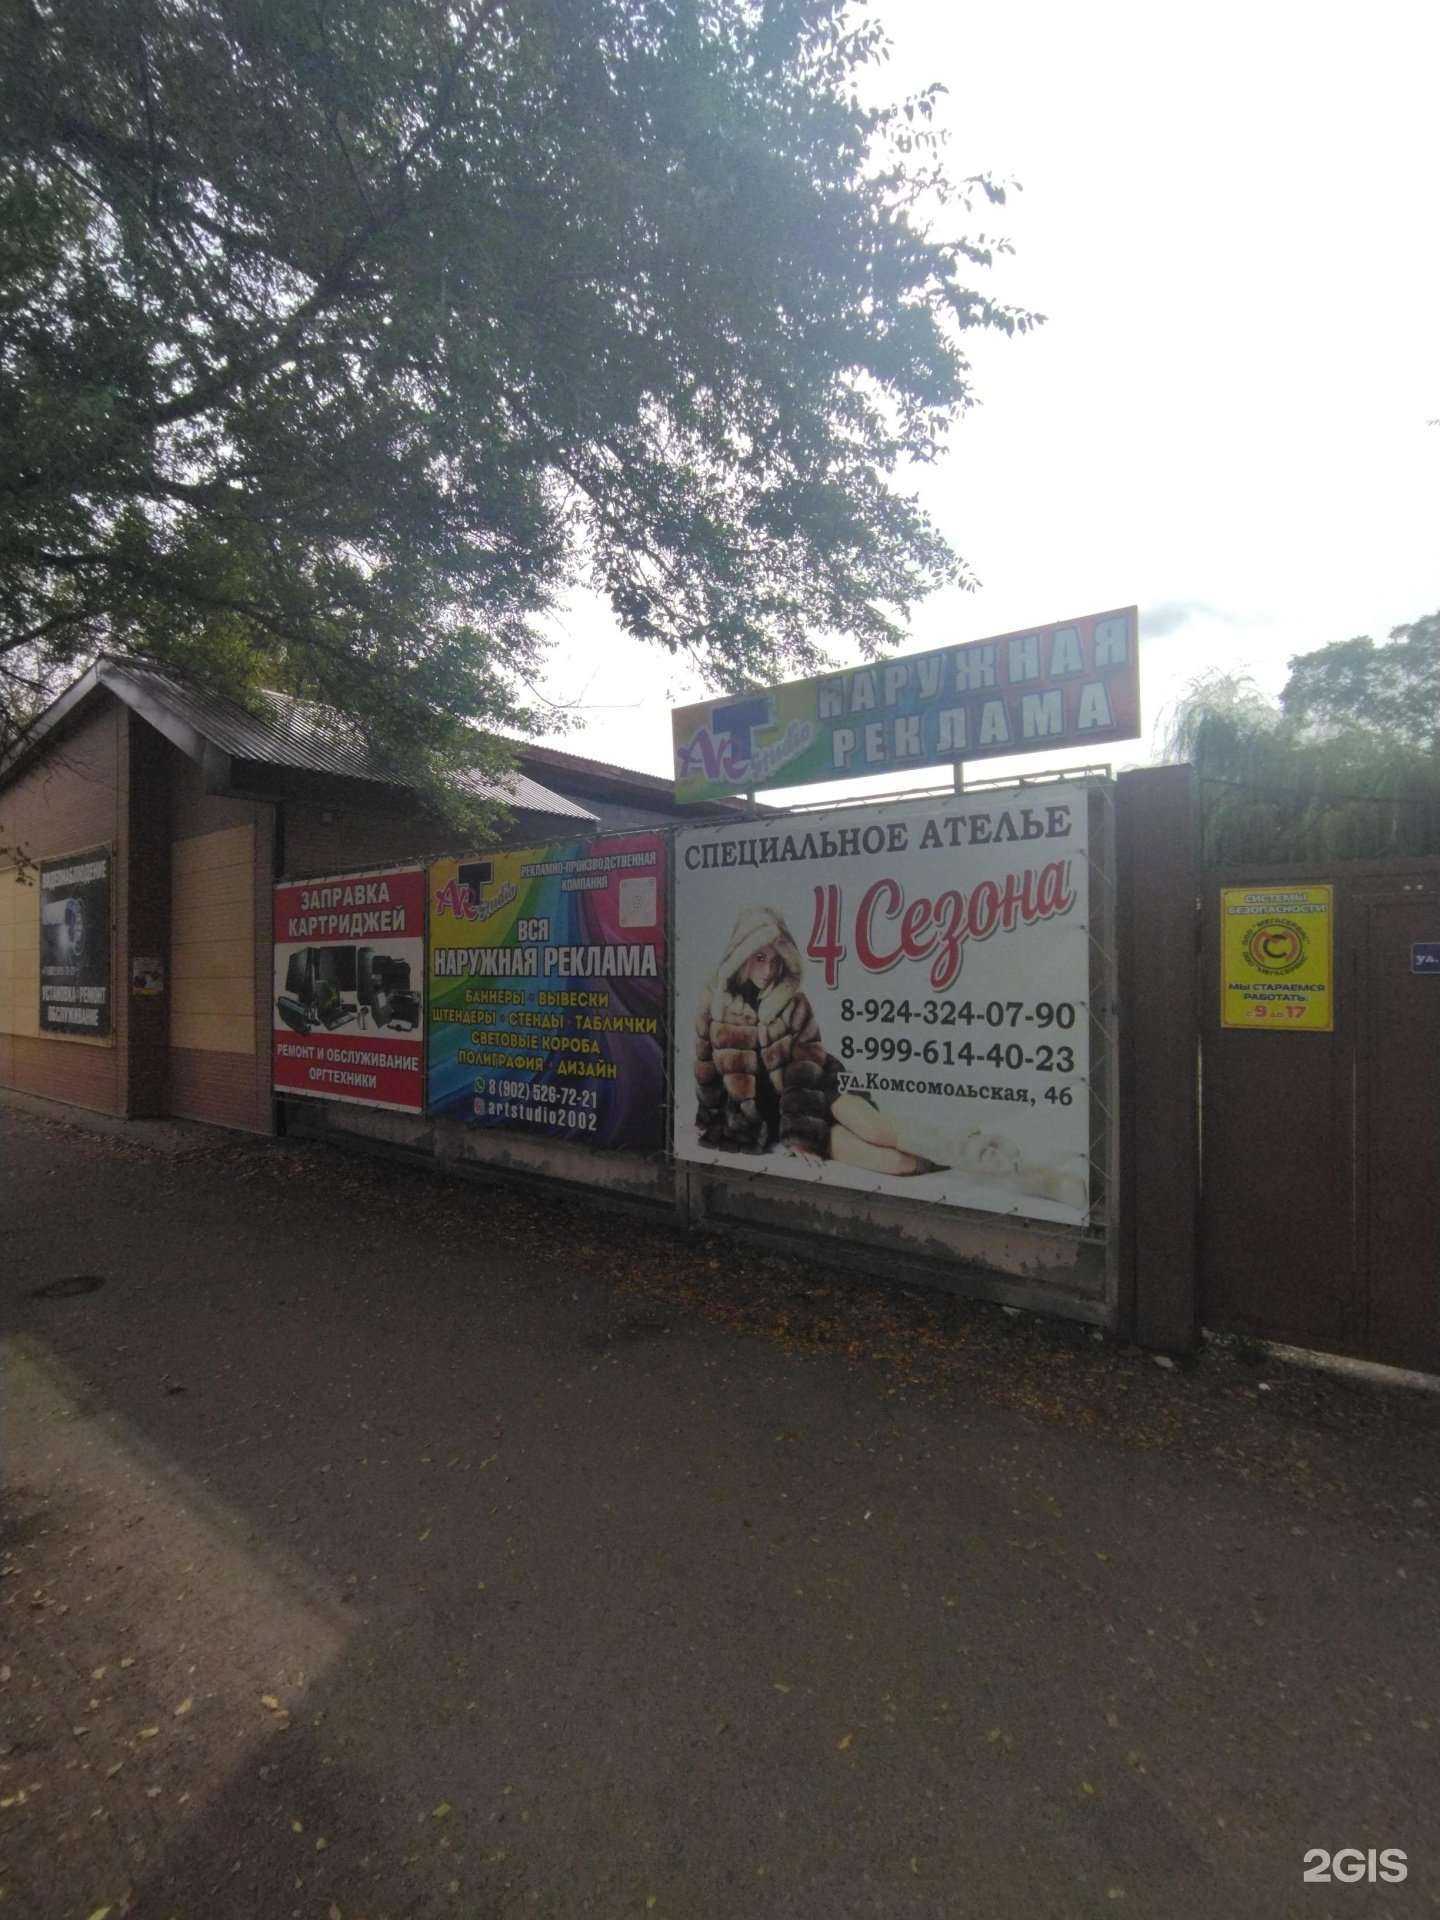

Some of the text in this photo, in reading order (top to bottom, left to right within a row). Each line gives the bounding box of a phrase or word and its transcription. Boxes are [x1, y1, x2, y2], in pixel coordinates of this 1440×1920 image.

[817, 619, 1129, 719] НАРУЖНАЯ
[831, 682, 1115, 768] РЕКЛАМА
[684, 805, 1072, 870] СПЕЦИАЛЬНОЕ АТЕЛЬЕ
[520, 851, 657, 877] РЕКЛАМНО-ПРОИЗВОДСТВЕННАЯ
[300, 881, 391, 911] ЗАПРАВКА
[560, 875, 609, 891] КОМПАНИЯ
[288, 904, 406, 937] КАРТРИДЖЕЙ
[518, 918, 550, 941] ВСЯ
[807, 860, 1074, 991] 4 Сезона
[434, 945, 658, 977] НАРУЖНАЯ РЕКЛАМА
[464, 989, 610, 1008] БАННЕРЫ ВЫВЕСКИ
[1228, 983, 1326, 992] МЫ СТАРАЕМСЯ
[431, 1008, 658, 1034] ШТЕНДЕРЫ СТЕНДЫ ТАБЛИЧКИ
[841, 998, 1076, 1029] 8-924-324-07-90
[1255, 1005, 1267, 1018] 9
[1286, 1005, 1307, 1018] 17
[277, 1043, 420, 1072] РЕМОНТ И ОБСЛУЖИВАНИЕ
[470, 1031, 601, 1054] СВЕТОВЫЕ КОРОБА
[841, 1036, 1075, 1073] 8-999-614-40-23
[308, 1067, 377, 1089] ОРГТЕХНИКИ
[458, 1049, 617, 1079] ПОЛИГРАФИЯ ДИЗАЙН
[488, 1078, 598, 1109] 8 (902) 526-72-21
[1044, 1086, 1074, 1106] 46
[488, 1101, 598, 1131] artstudio2002
